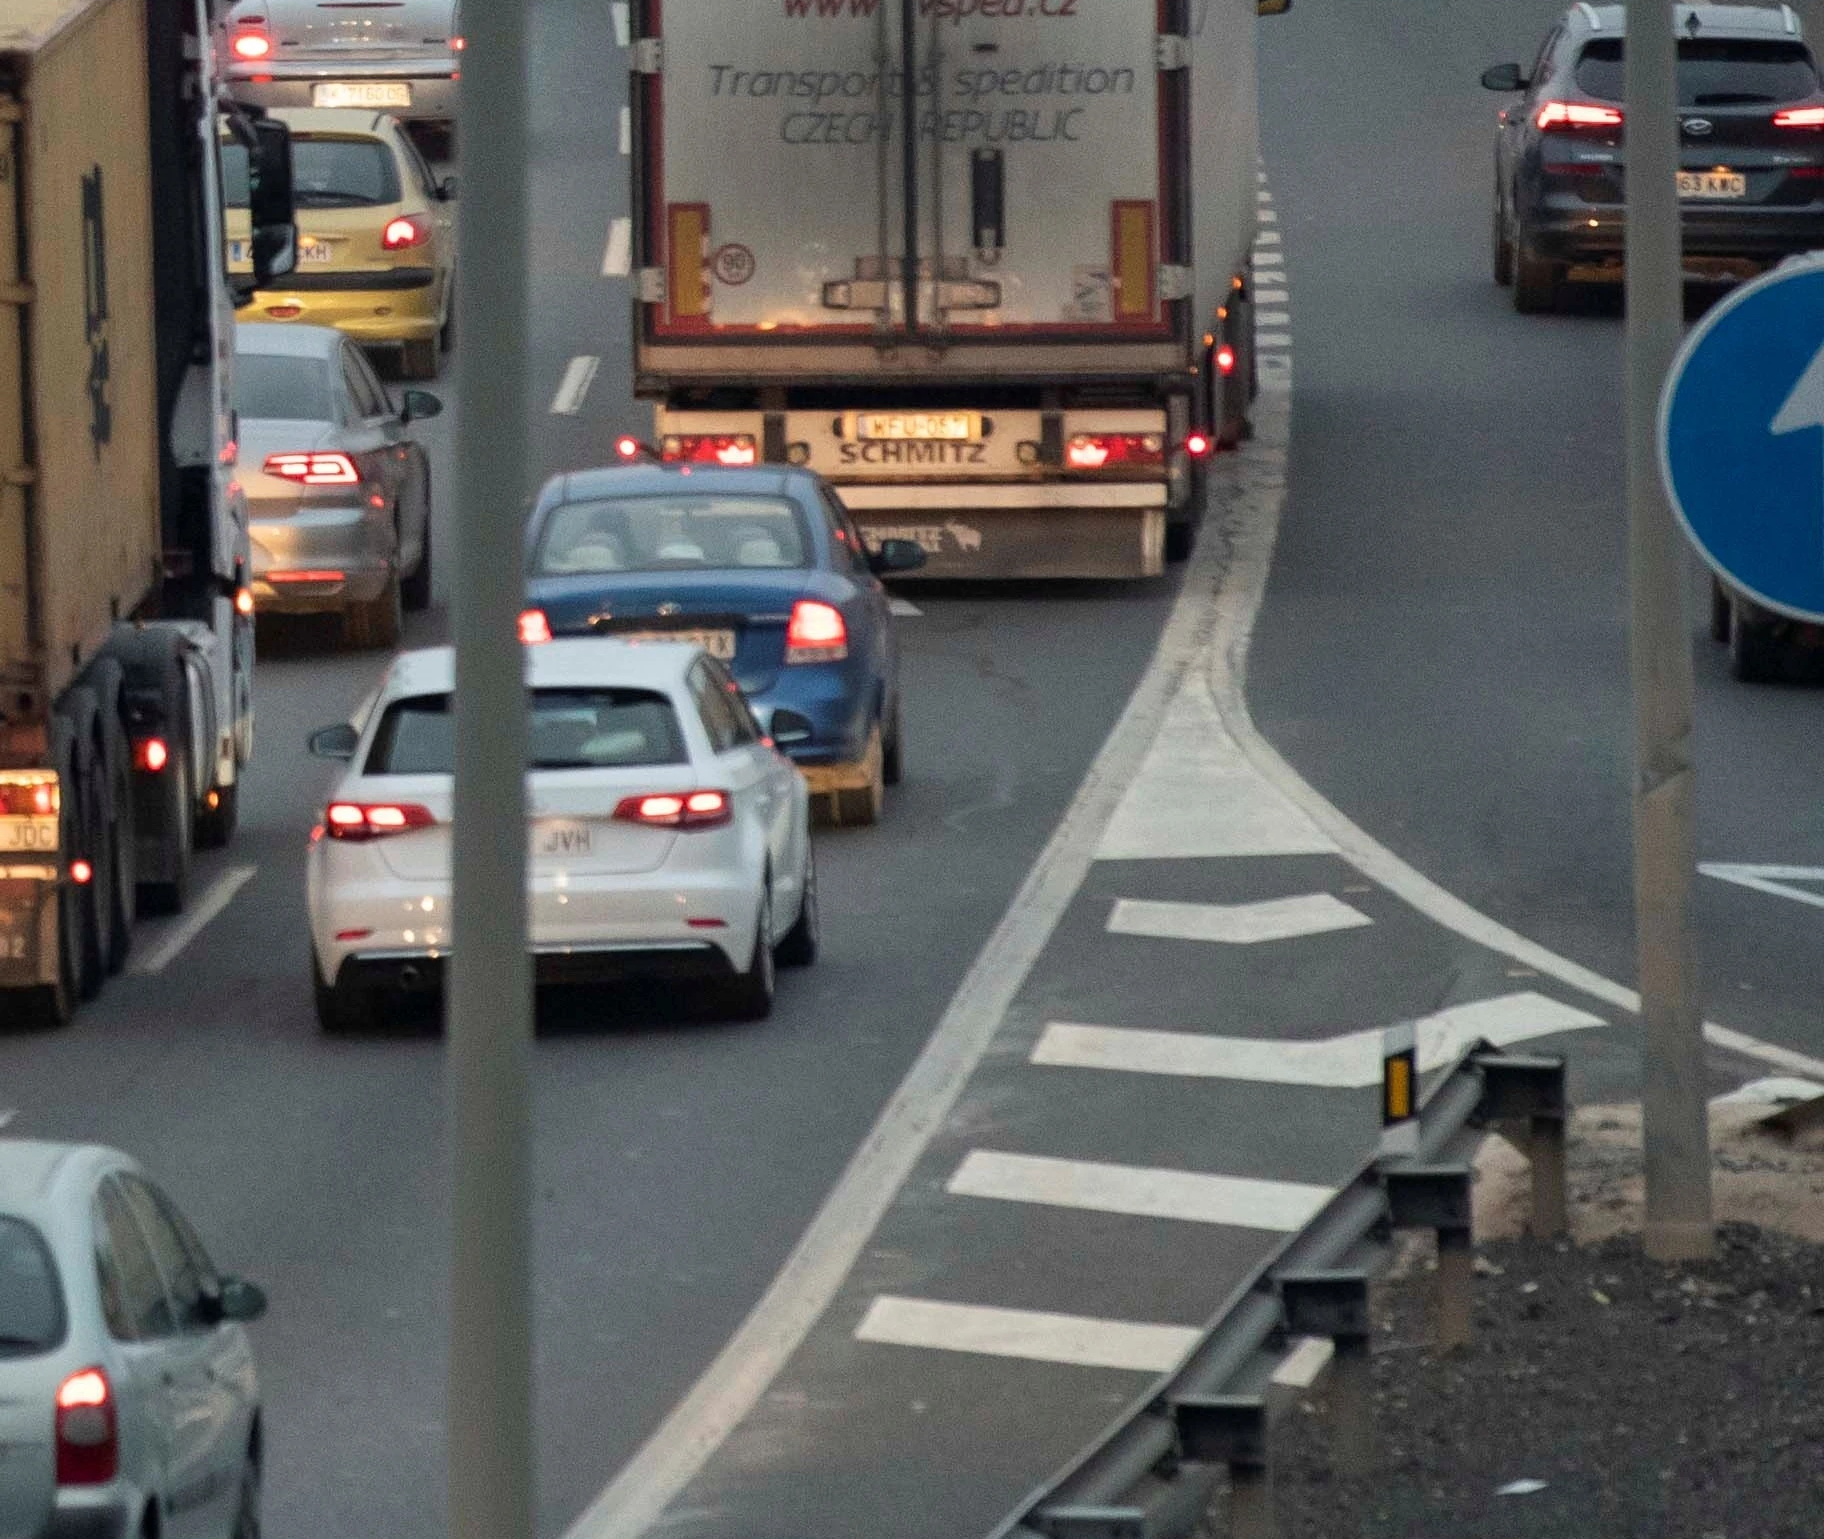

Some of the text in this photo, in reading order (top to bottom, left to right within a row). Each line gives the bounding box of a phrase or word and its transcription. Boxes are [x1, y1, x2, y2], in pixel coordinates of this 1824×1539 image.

[954, 62, 1135, 104] spedition
[916, 109, 1084, 143] REPUBLIC
[840, 441, 986, 464] SCHMITZ
[8, 825, 54, 845] JDC
